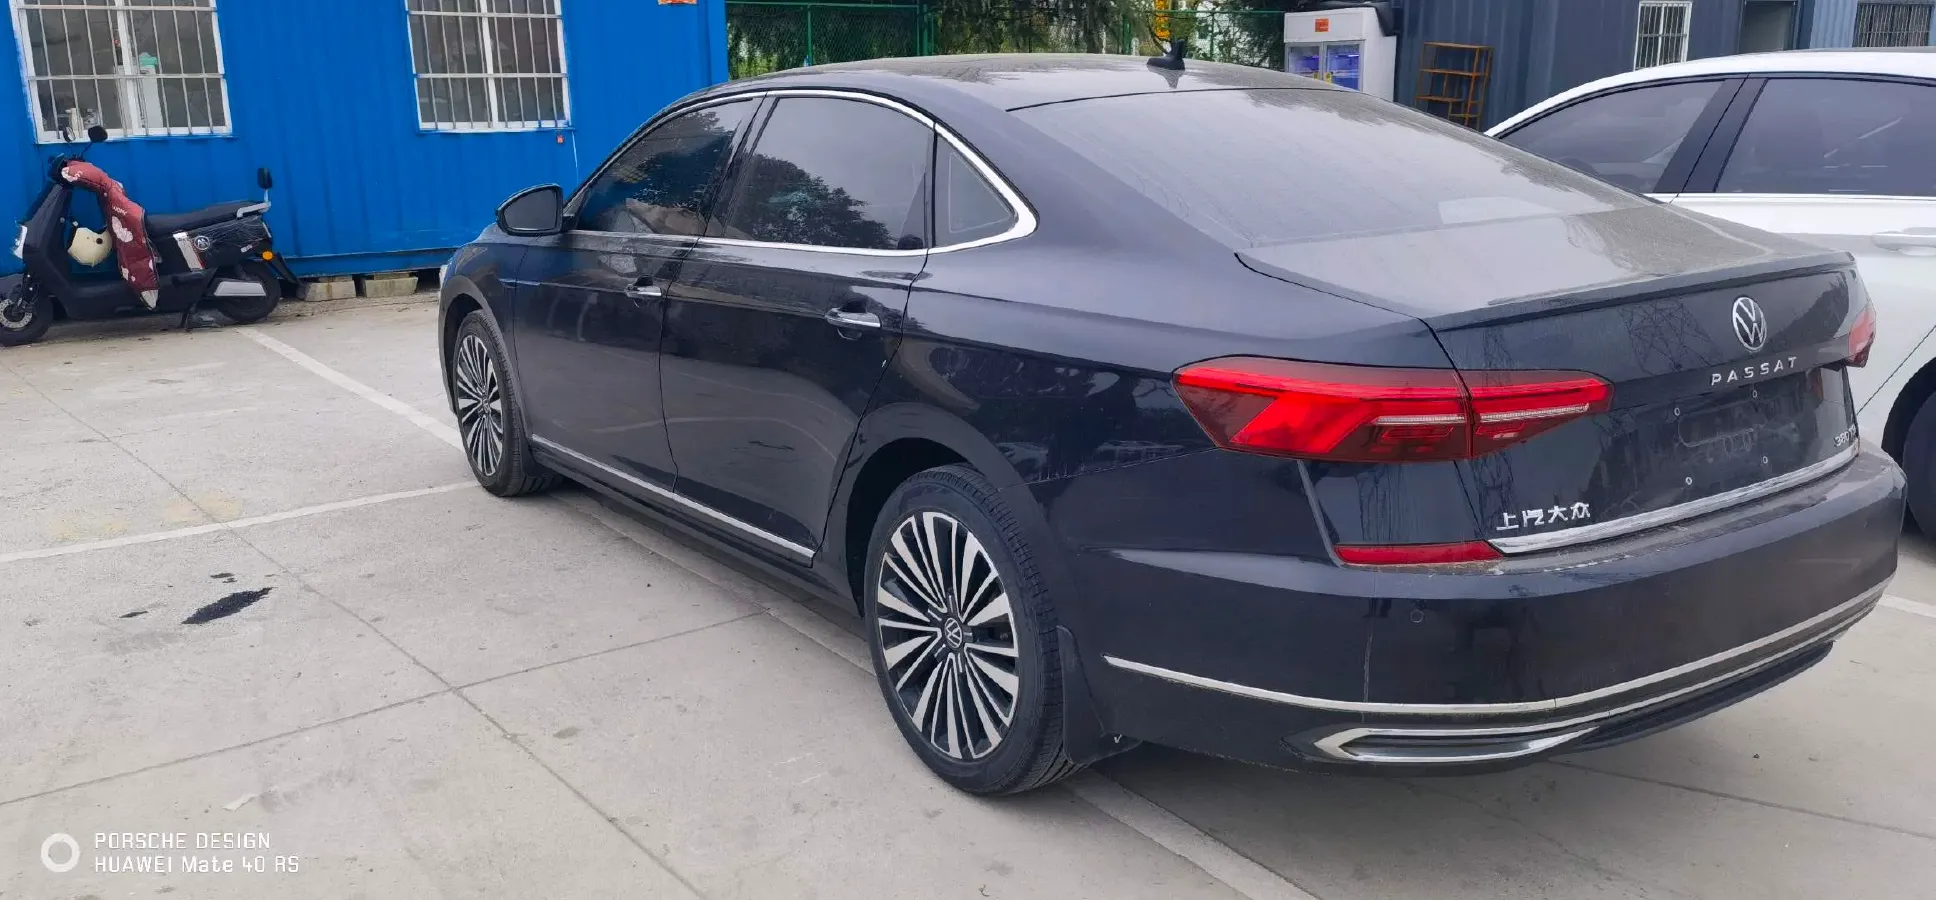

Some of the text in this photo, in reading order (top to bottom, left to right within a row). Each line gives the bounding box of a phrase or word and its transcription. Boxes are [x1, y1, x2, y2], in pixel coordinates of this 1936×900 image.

[1711, 356, 1797, 386] PASSAT
[1496, 502, 1591, 531] 上汽大众
